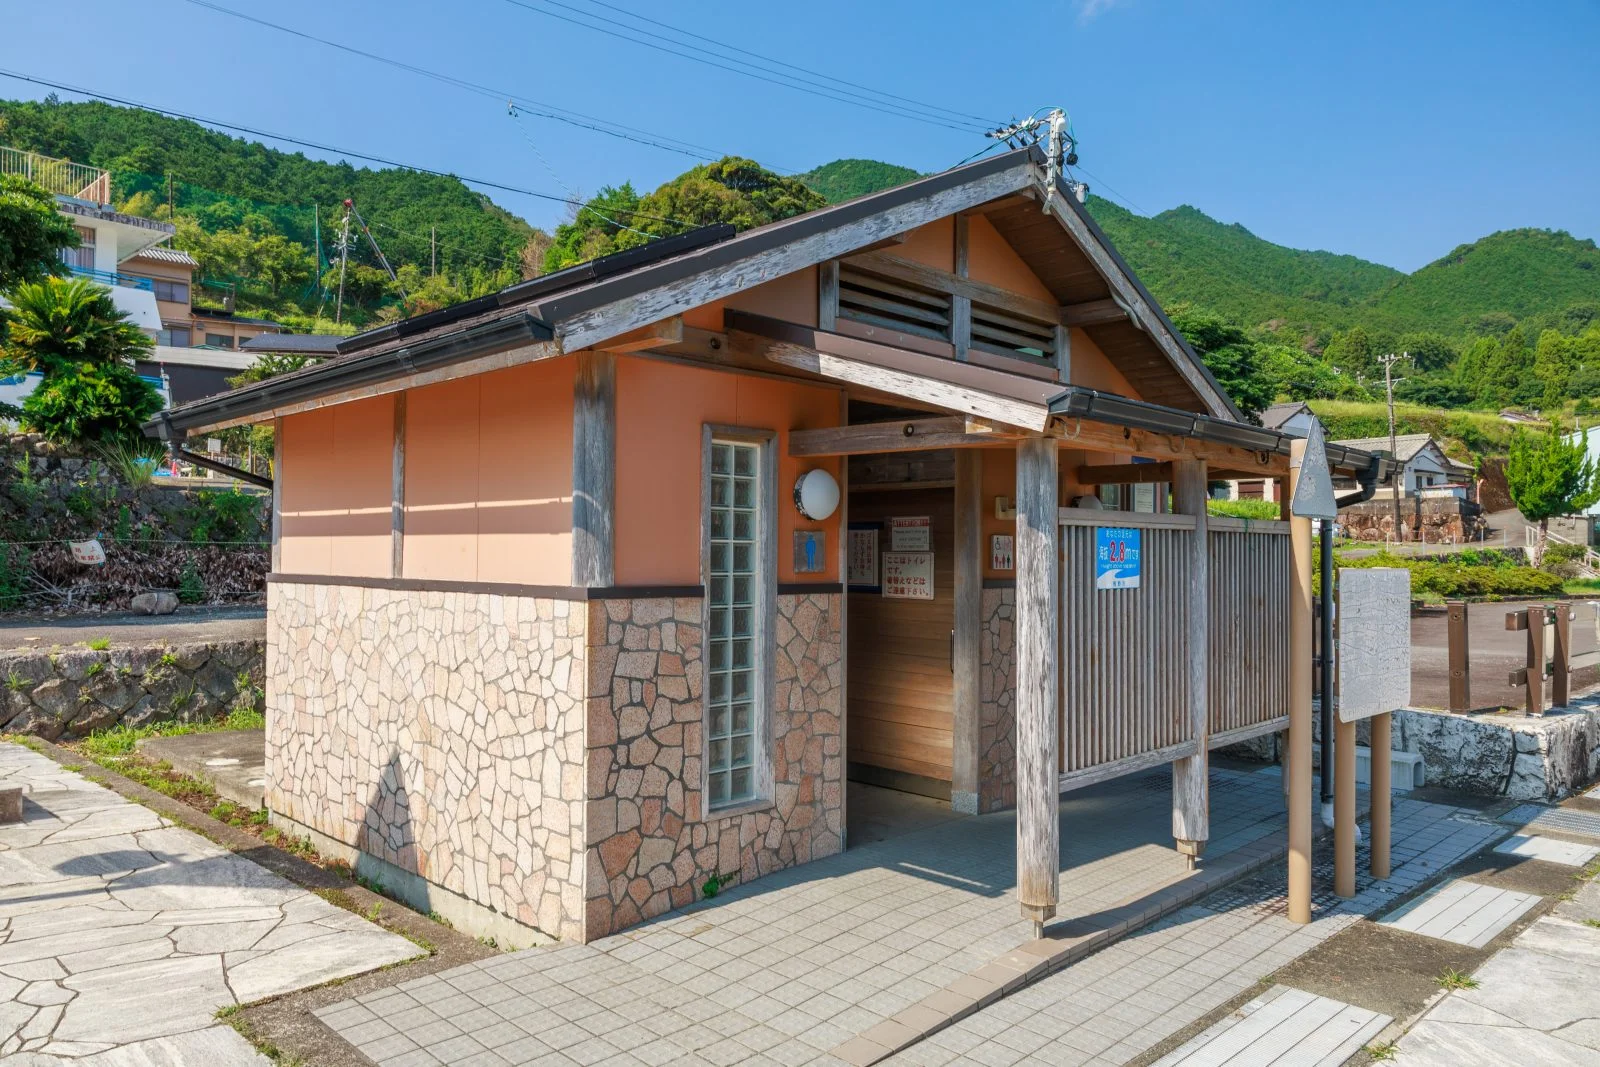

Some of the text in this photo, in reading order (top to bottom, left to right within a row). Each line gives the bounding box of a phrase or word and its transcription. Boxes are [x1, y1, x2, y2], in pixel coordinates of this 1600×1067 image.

[887, 556, 926, 566] ここはトイレ
